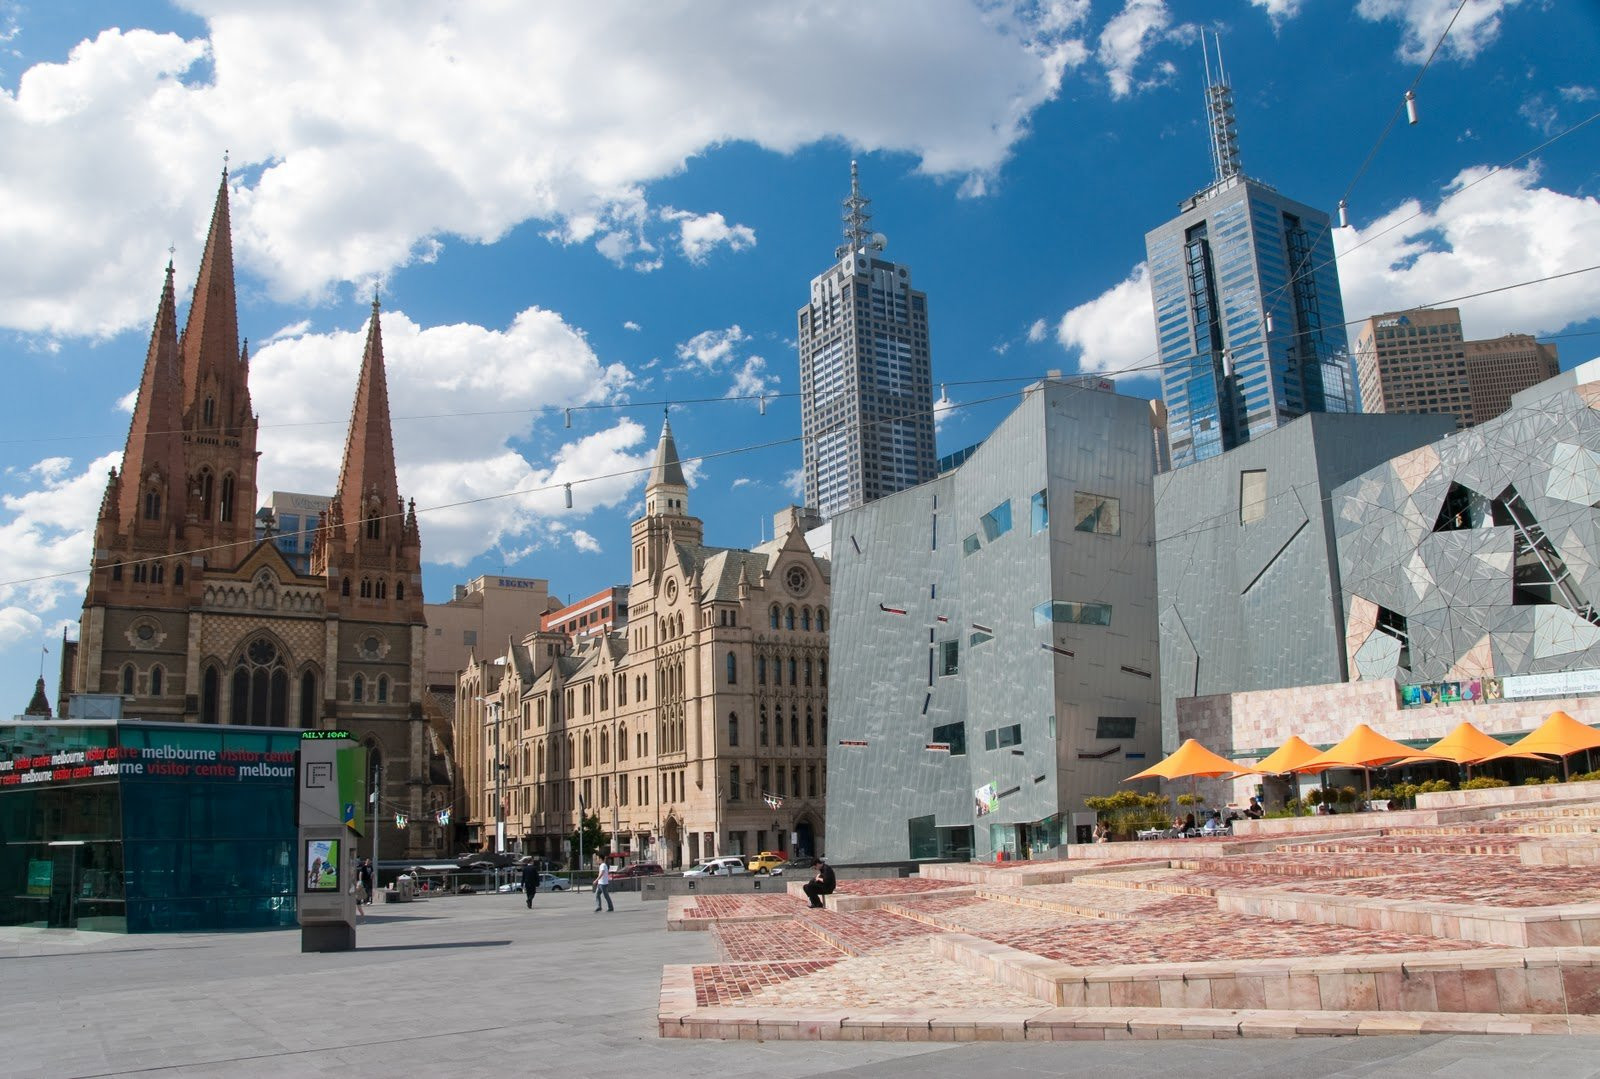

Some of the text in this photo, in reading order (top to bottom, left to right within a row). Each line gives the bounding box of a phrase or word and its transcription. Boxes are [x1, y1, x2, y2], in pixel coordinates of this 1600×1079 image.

[499, 579, 535, 589] REGENT
[14, 757, 31, 769] visitor
[32, 755, 51, 767] centre
[52, 750, 84, 765] melbourne
[86, 747, 105, 760] visitor
[142, 744, 216, 760] melbourne
[219, 748, 260, 762] visitor
[263, 751, 295, 763] centr
[21, 769, 52, 783] melbourne
[53, 766, 72, 780] visitor
[73, 765, 92, 778] centre
[93, 760, 143, 776] melbourne
[147, 760, 190, 775] visitor
[195, 763, 236, 776] centre
